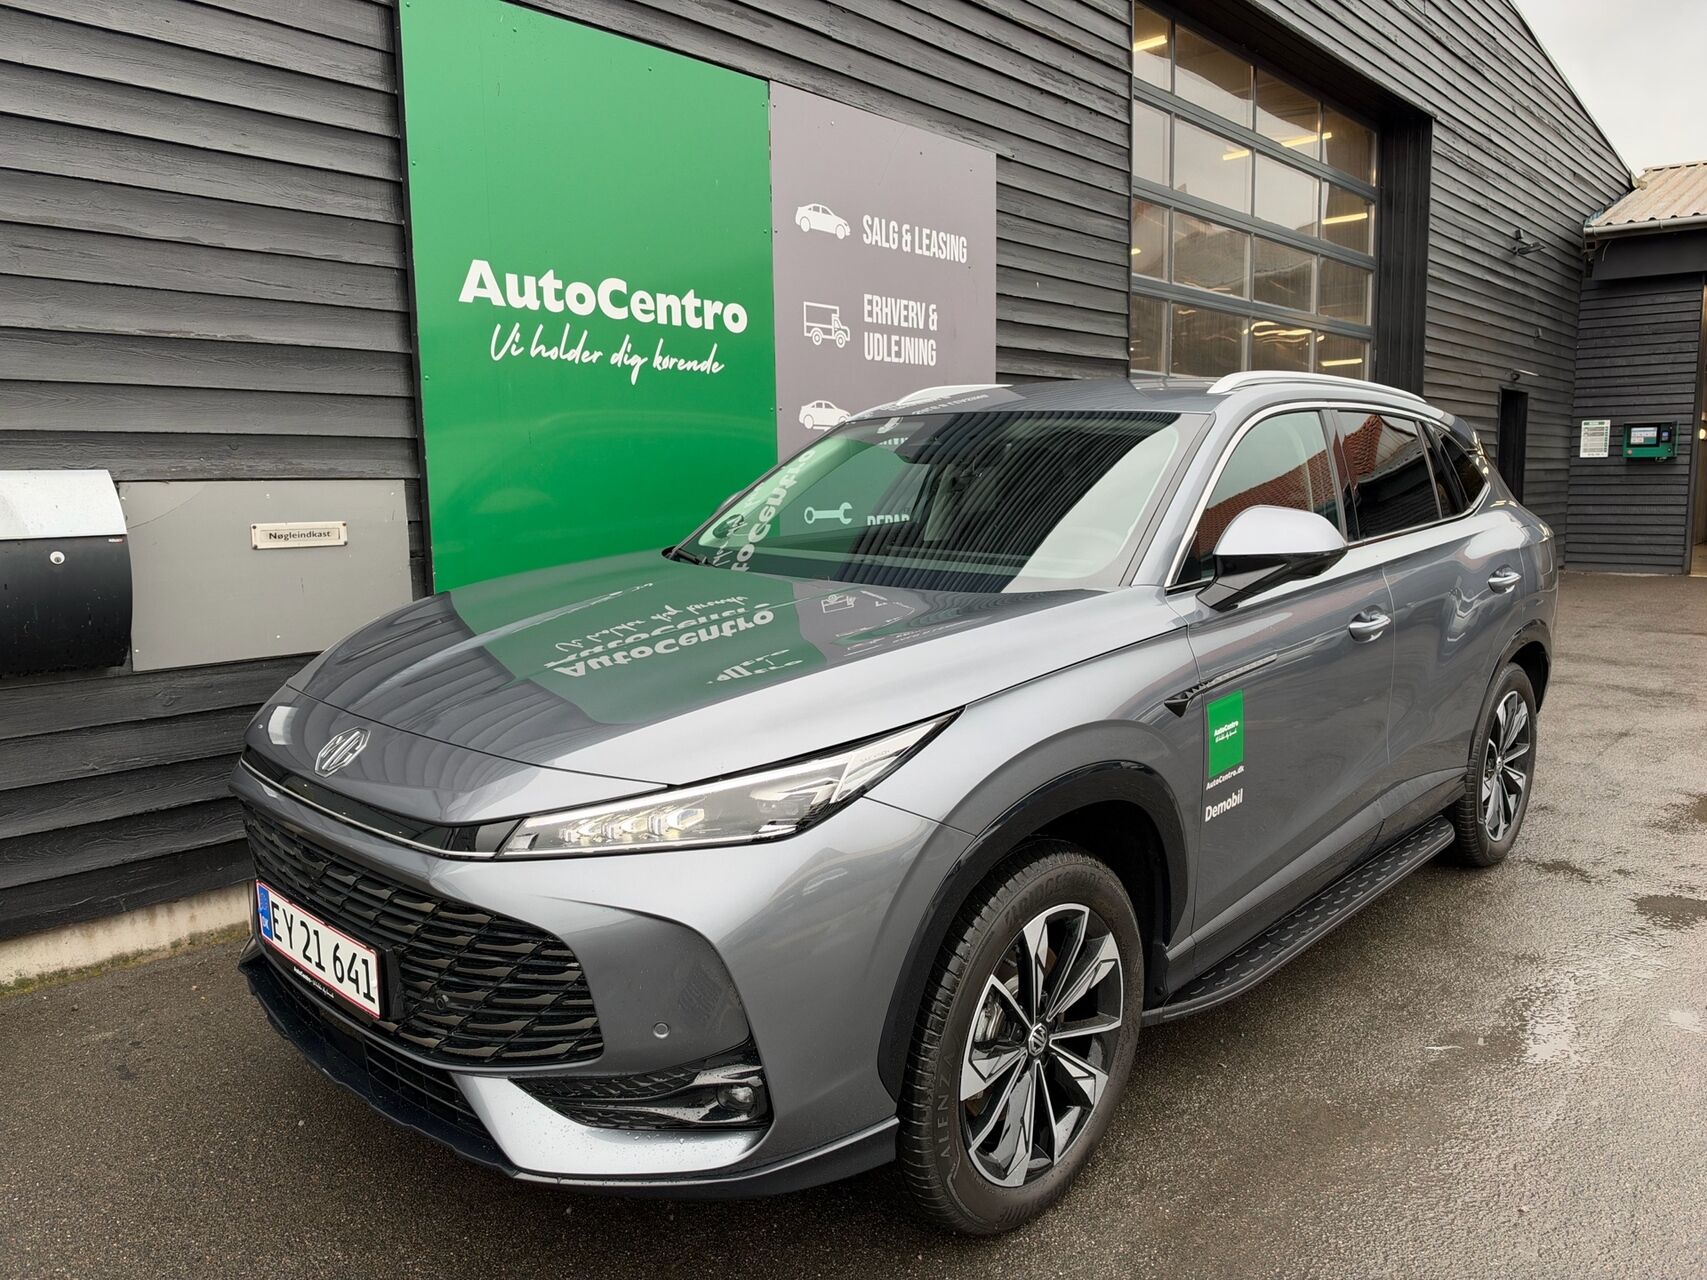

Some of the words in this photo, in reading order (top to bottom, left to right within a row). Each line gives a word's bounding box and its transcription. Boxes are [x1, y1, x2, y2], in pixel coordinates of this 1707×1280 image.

[862, 214, 899, 250] SALG
[901, 223, 912, 253] &
[915, 226, 968, 264] LEASING
[458, 259, 748, 334] AutoCentro
[863, 293, 926, 330] ERHVERV
[928, 303, 938, 331] &
[490, 322, 524, 361] Vi
[529, 322, 604, 364] holder
[609, 333, 649, 386] dig
[863, 331, 937, 367] UDLEJNING
[268, 530, 332, 541] Nøgleindkast
[1206, 765, 1245, 790] AutoCentro.dk
[1205, 788, 1244, 822] Demobil
[270, 899, 294, 950] EY
[299, 919, 326, 973] 21
[332, 942, 376, 1004] 641
